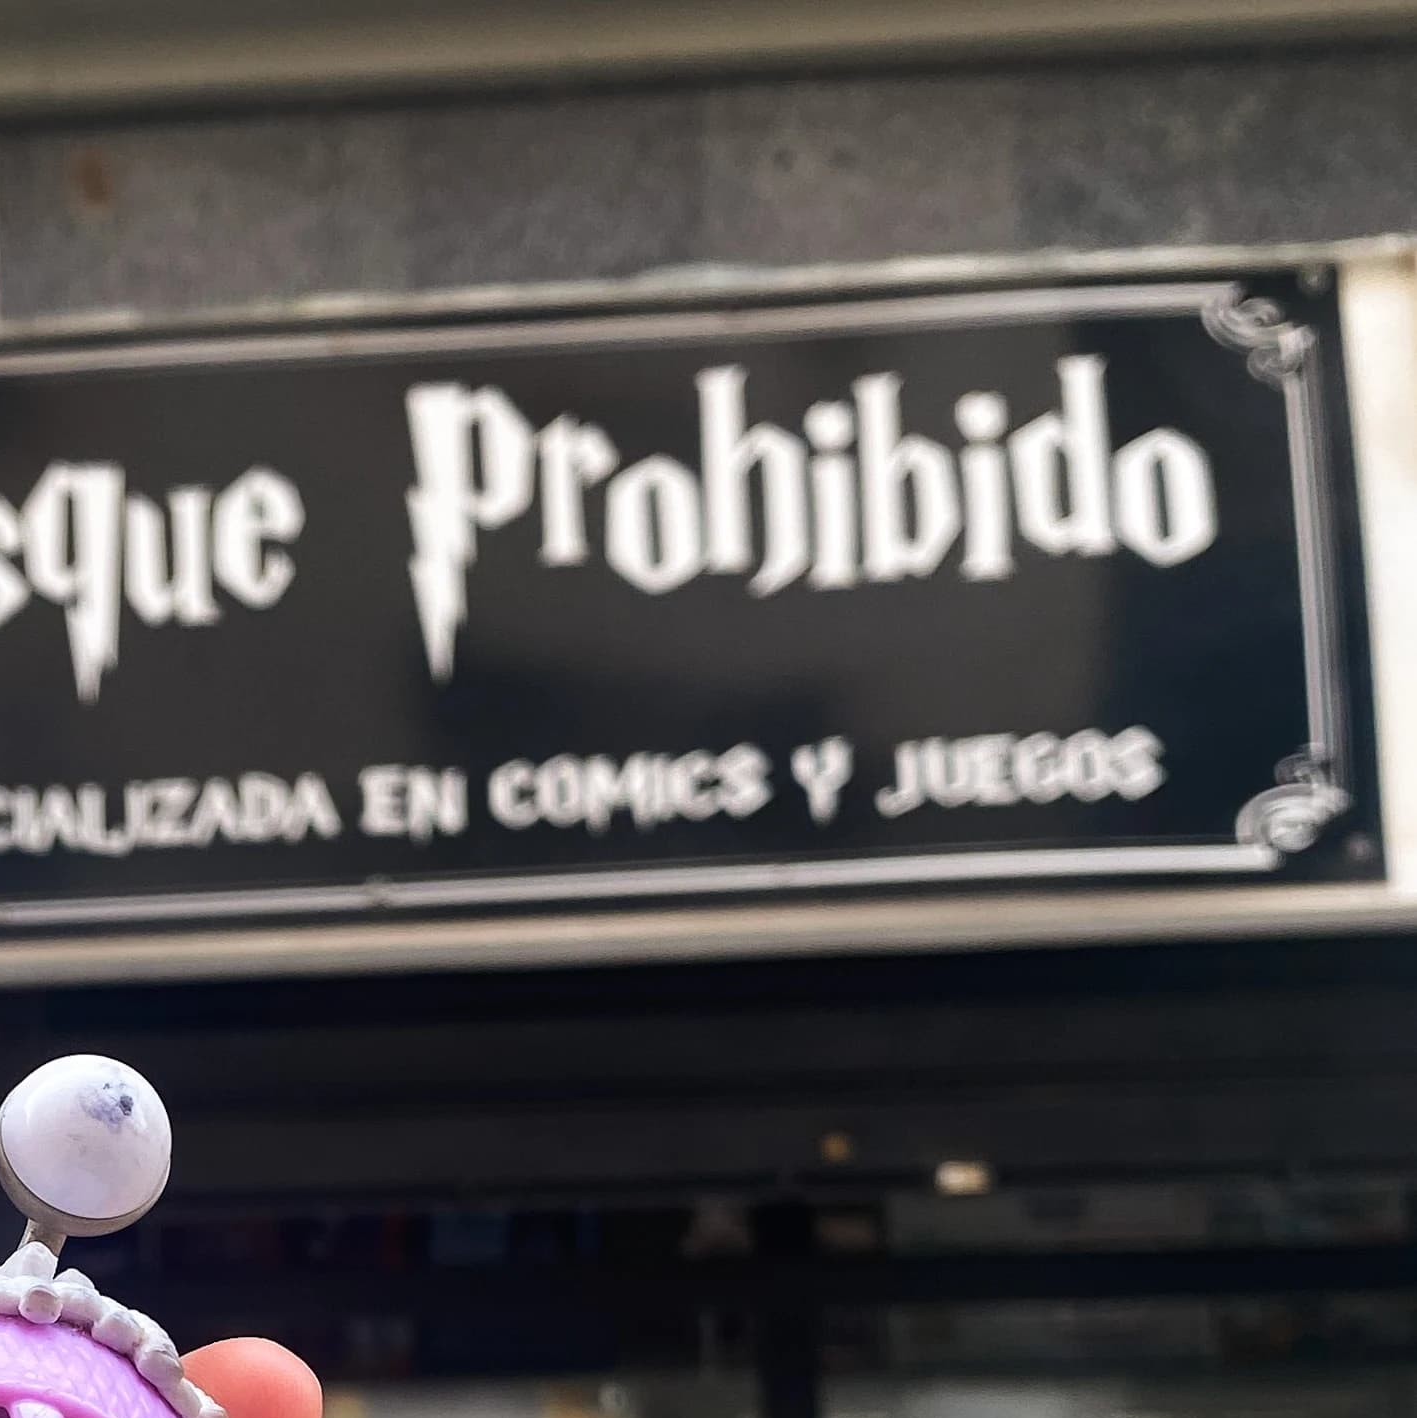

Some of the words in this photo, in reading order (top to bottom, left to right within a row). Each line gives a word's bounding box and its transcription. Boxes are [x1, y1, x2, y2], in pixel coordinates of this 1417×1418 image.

[406, 354, 1218, 685] Prohibido
[358, 766, 467, 842] EN
[488, 744, 771, 833] COMICS
[792, 735, 852, 822] Y
[876, 724, 1165, 818] JUEGOS
